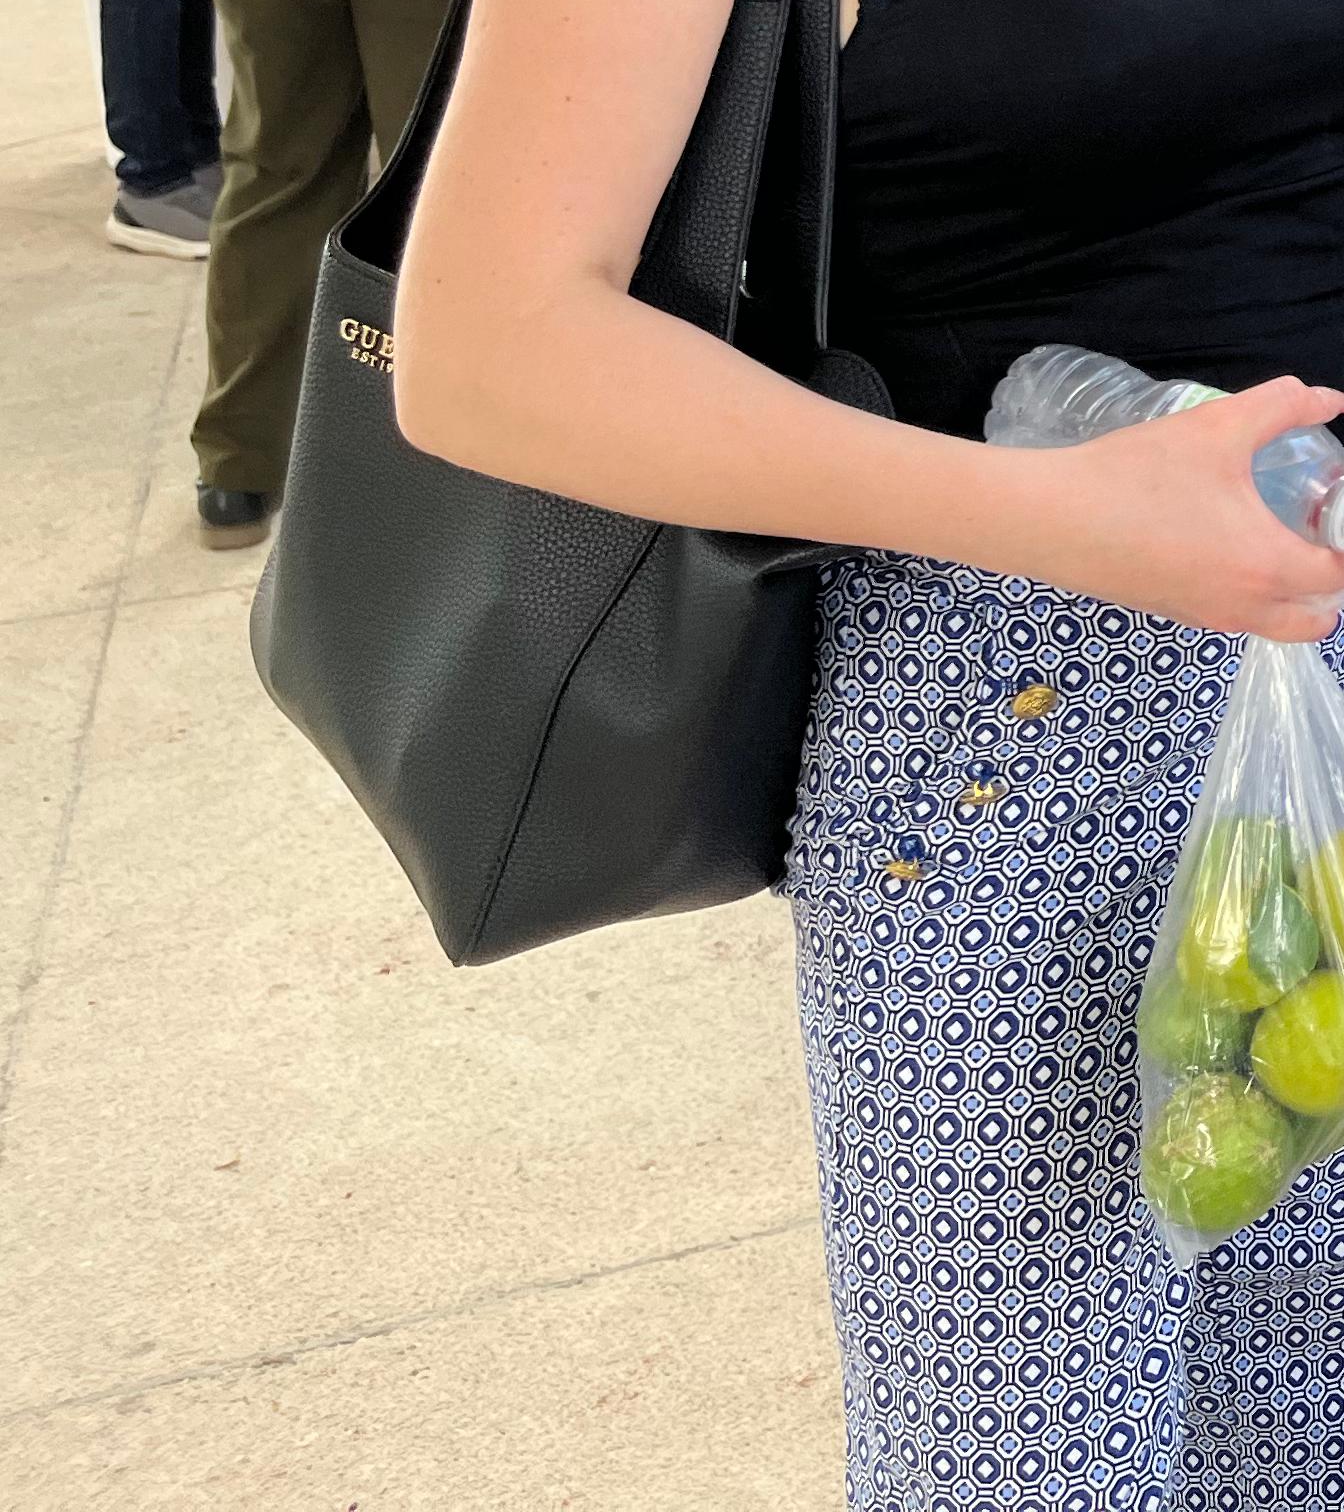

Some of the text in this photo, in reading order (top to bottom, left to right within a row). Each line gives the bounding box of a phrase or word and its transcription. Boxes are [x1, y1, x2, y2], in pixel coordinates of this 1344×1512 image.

[339, 317, 394, 360] GUE
[351, 347, 394, 374] EST 19
